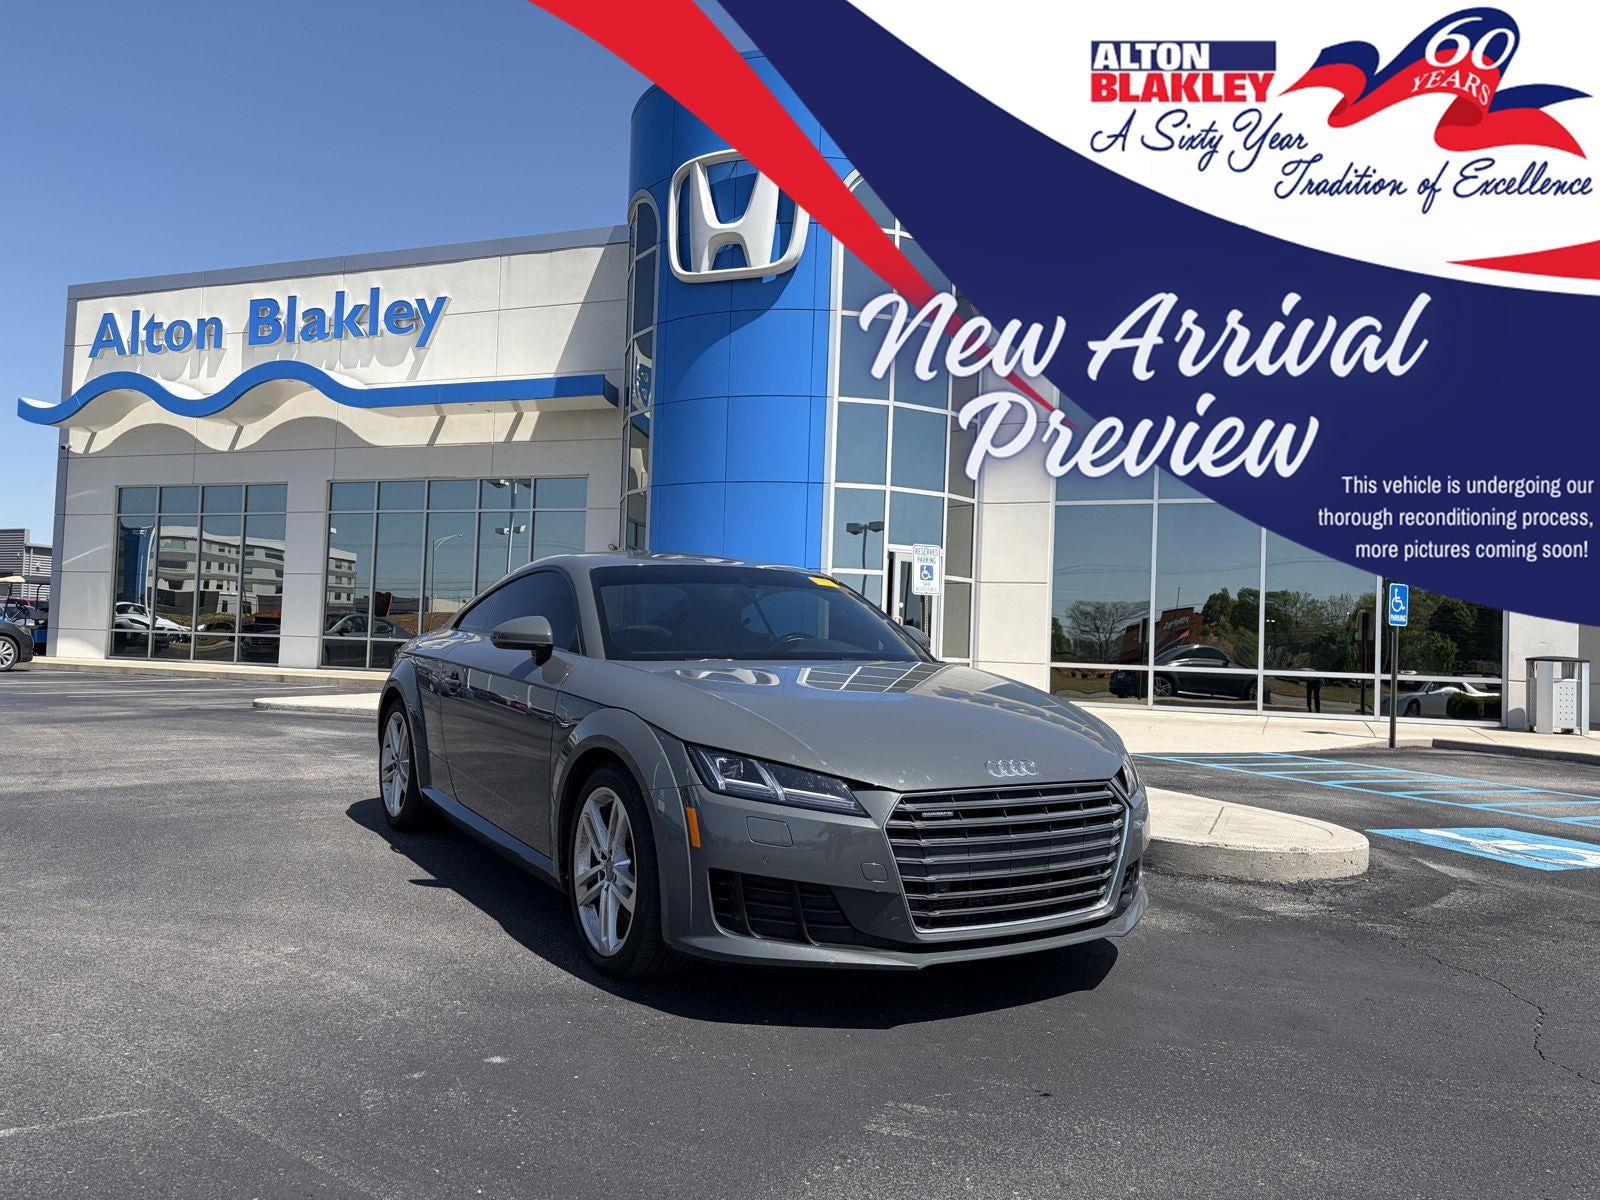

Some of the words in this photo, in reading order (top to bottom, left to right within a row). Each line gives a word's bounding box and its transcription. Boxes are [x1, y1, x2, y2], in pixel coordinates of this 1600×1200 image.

[89, 309, 224, 359] Alton
[248, 287, 450, 348] Blakley
[914, 547, 939, 556] RESERVED
[917, 556, 937, 564] PARKING
[1390, 614, 1407, 622] PARKING
